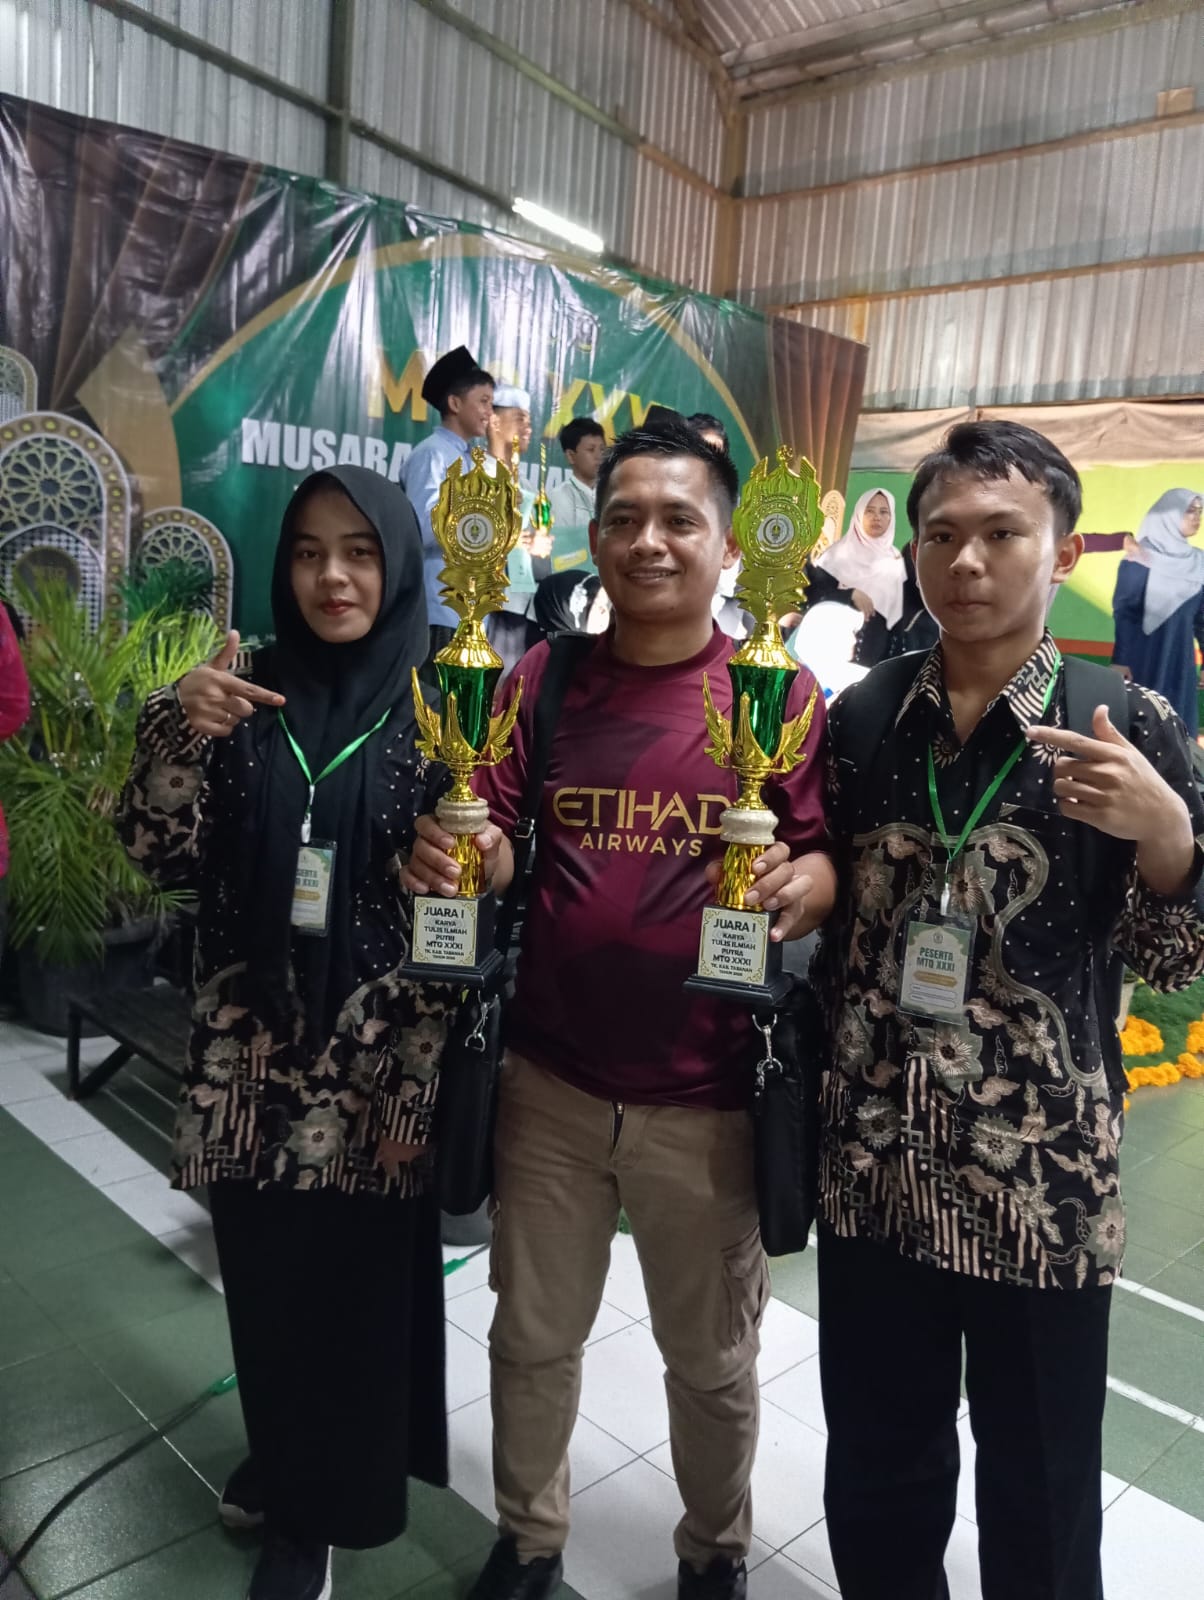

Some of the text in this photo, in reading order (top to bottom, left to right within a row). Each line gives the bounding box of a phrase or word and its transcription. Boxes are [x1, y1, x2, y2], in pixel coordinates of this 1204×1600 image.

[552, 786, 734, 835] ETIHAD
[579, 832, 704, 857] AIRWAYS
[424, 906, 465, 919] JUARA I
[444, 927, 467, 935] ILMIAH
[713, 918, 756, 933] JUARA I
[712, 939, 756, 950] TULIS ILMIAH
[722, 948, 743, 956] PUTRA
[919, 947, 953, 961] PESERTA
[713, 954, 751, 966] MTQ XXXI
